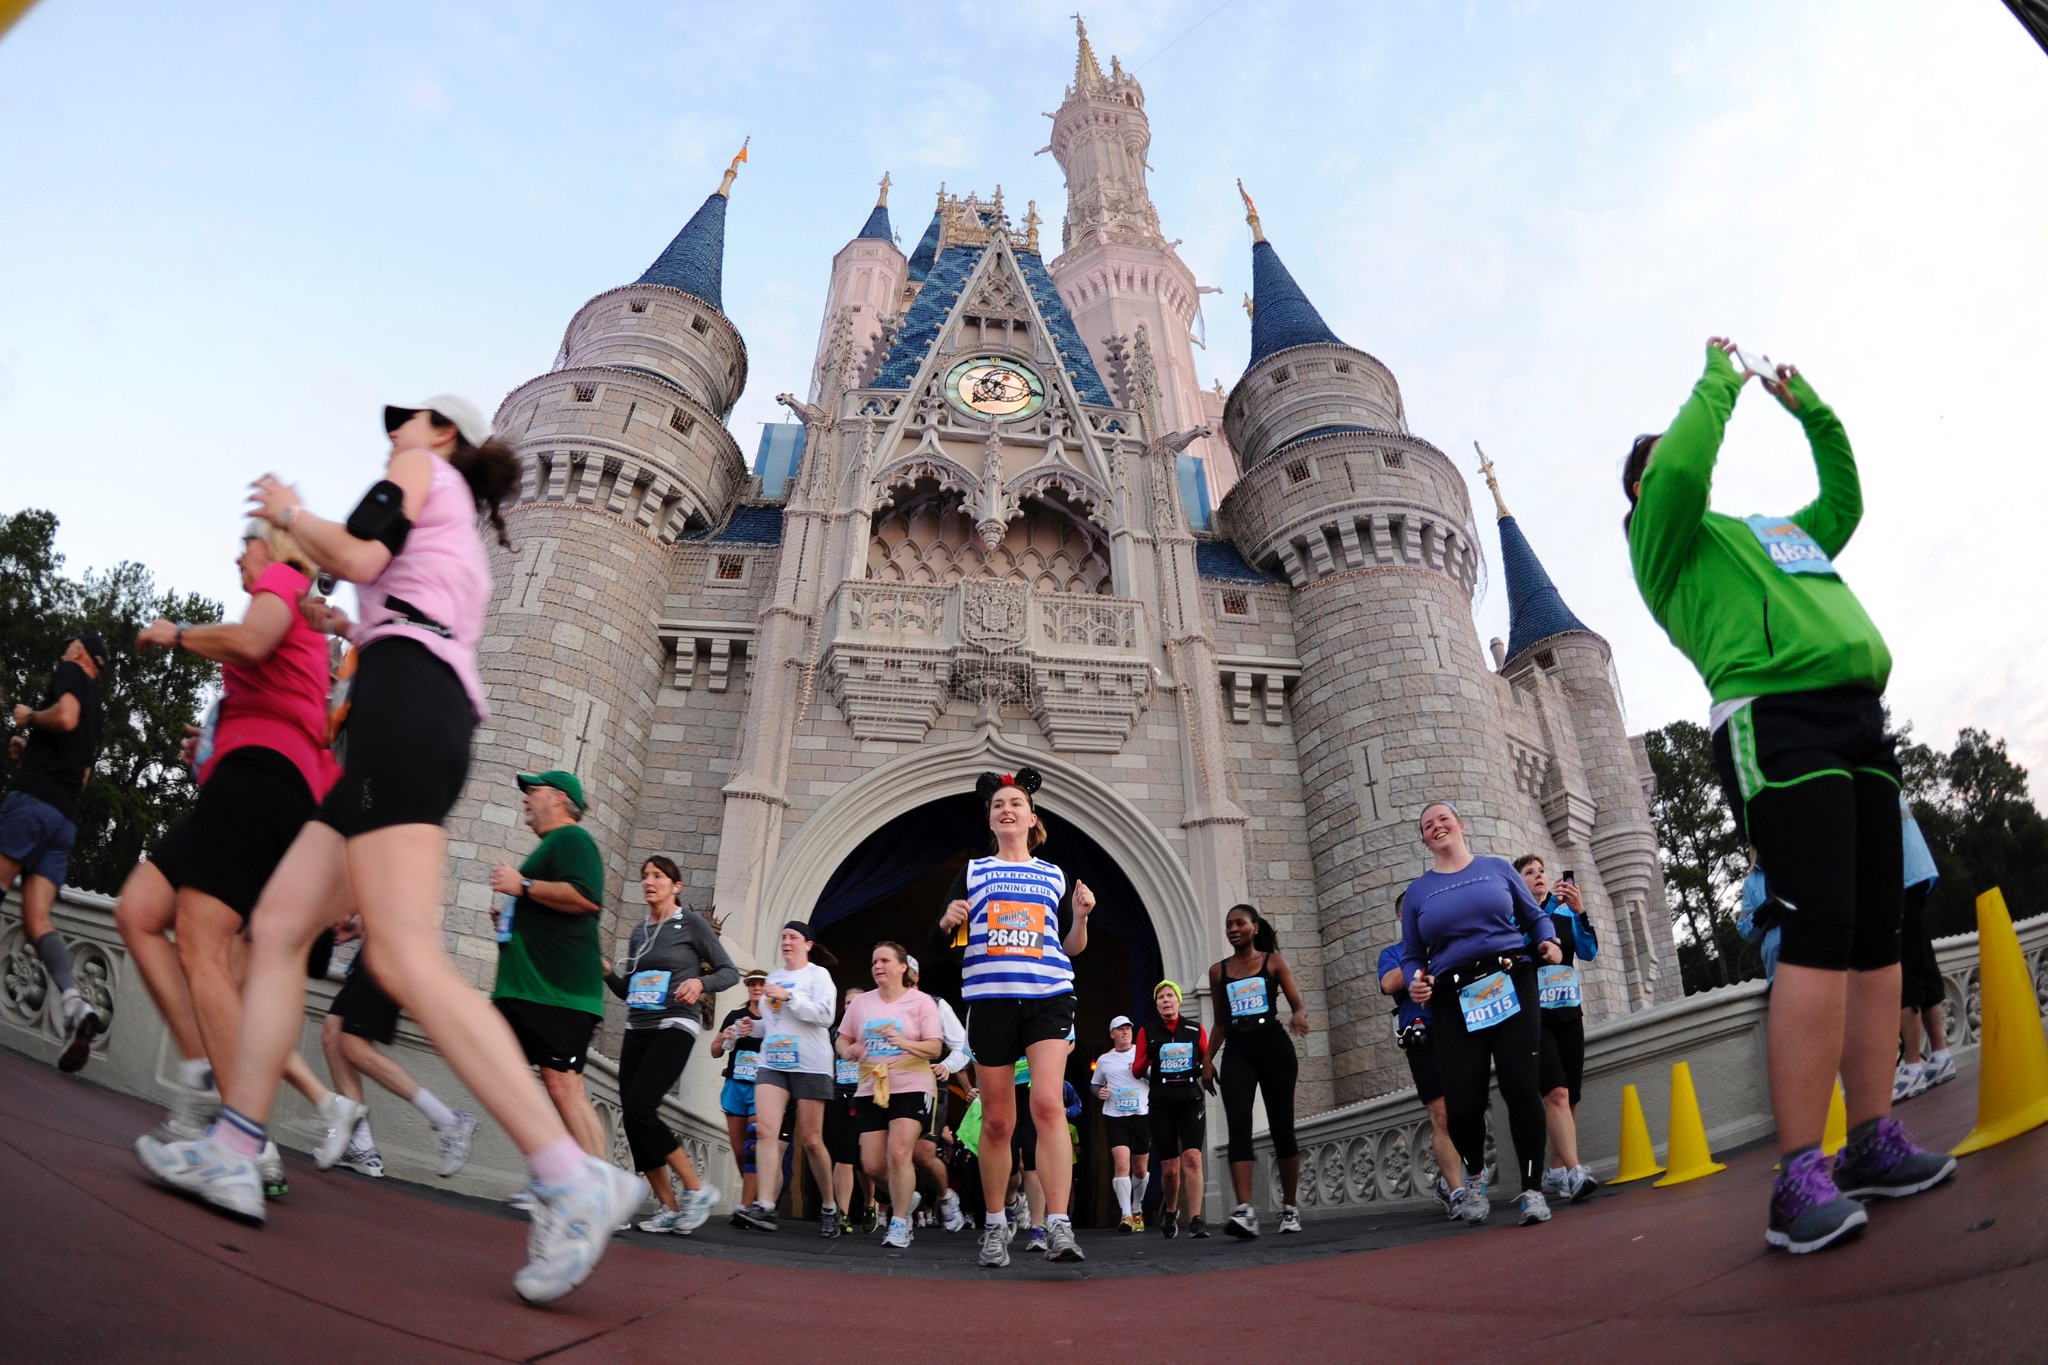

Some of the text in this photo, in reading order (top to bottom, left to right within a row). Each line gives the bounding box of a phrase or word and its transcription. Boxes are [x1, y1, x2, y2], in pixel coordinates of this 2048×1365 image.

[985, 871, 1048, 881] LIVERPOOL
[985, 884, 1051, 897] RUNNING CLUB
[987, 928, 1039, 947] 26497
[1539, 986, 1576, 1002] 49713
[1230, 995, 1264, 1012] 51738
[1466, 995, 1513, 1023] 40115
[1160, 1058, 1190, 1069] 48622
